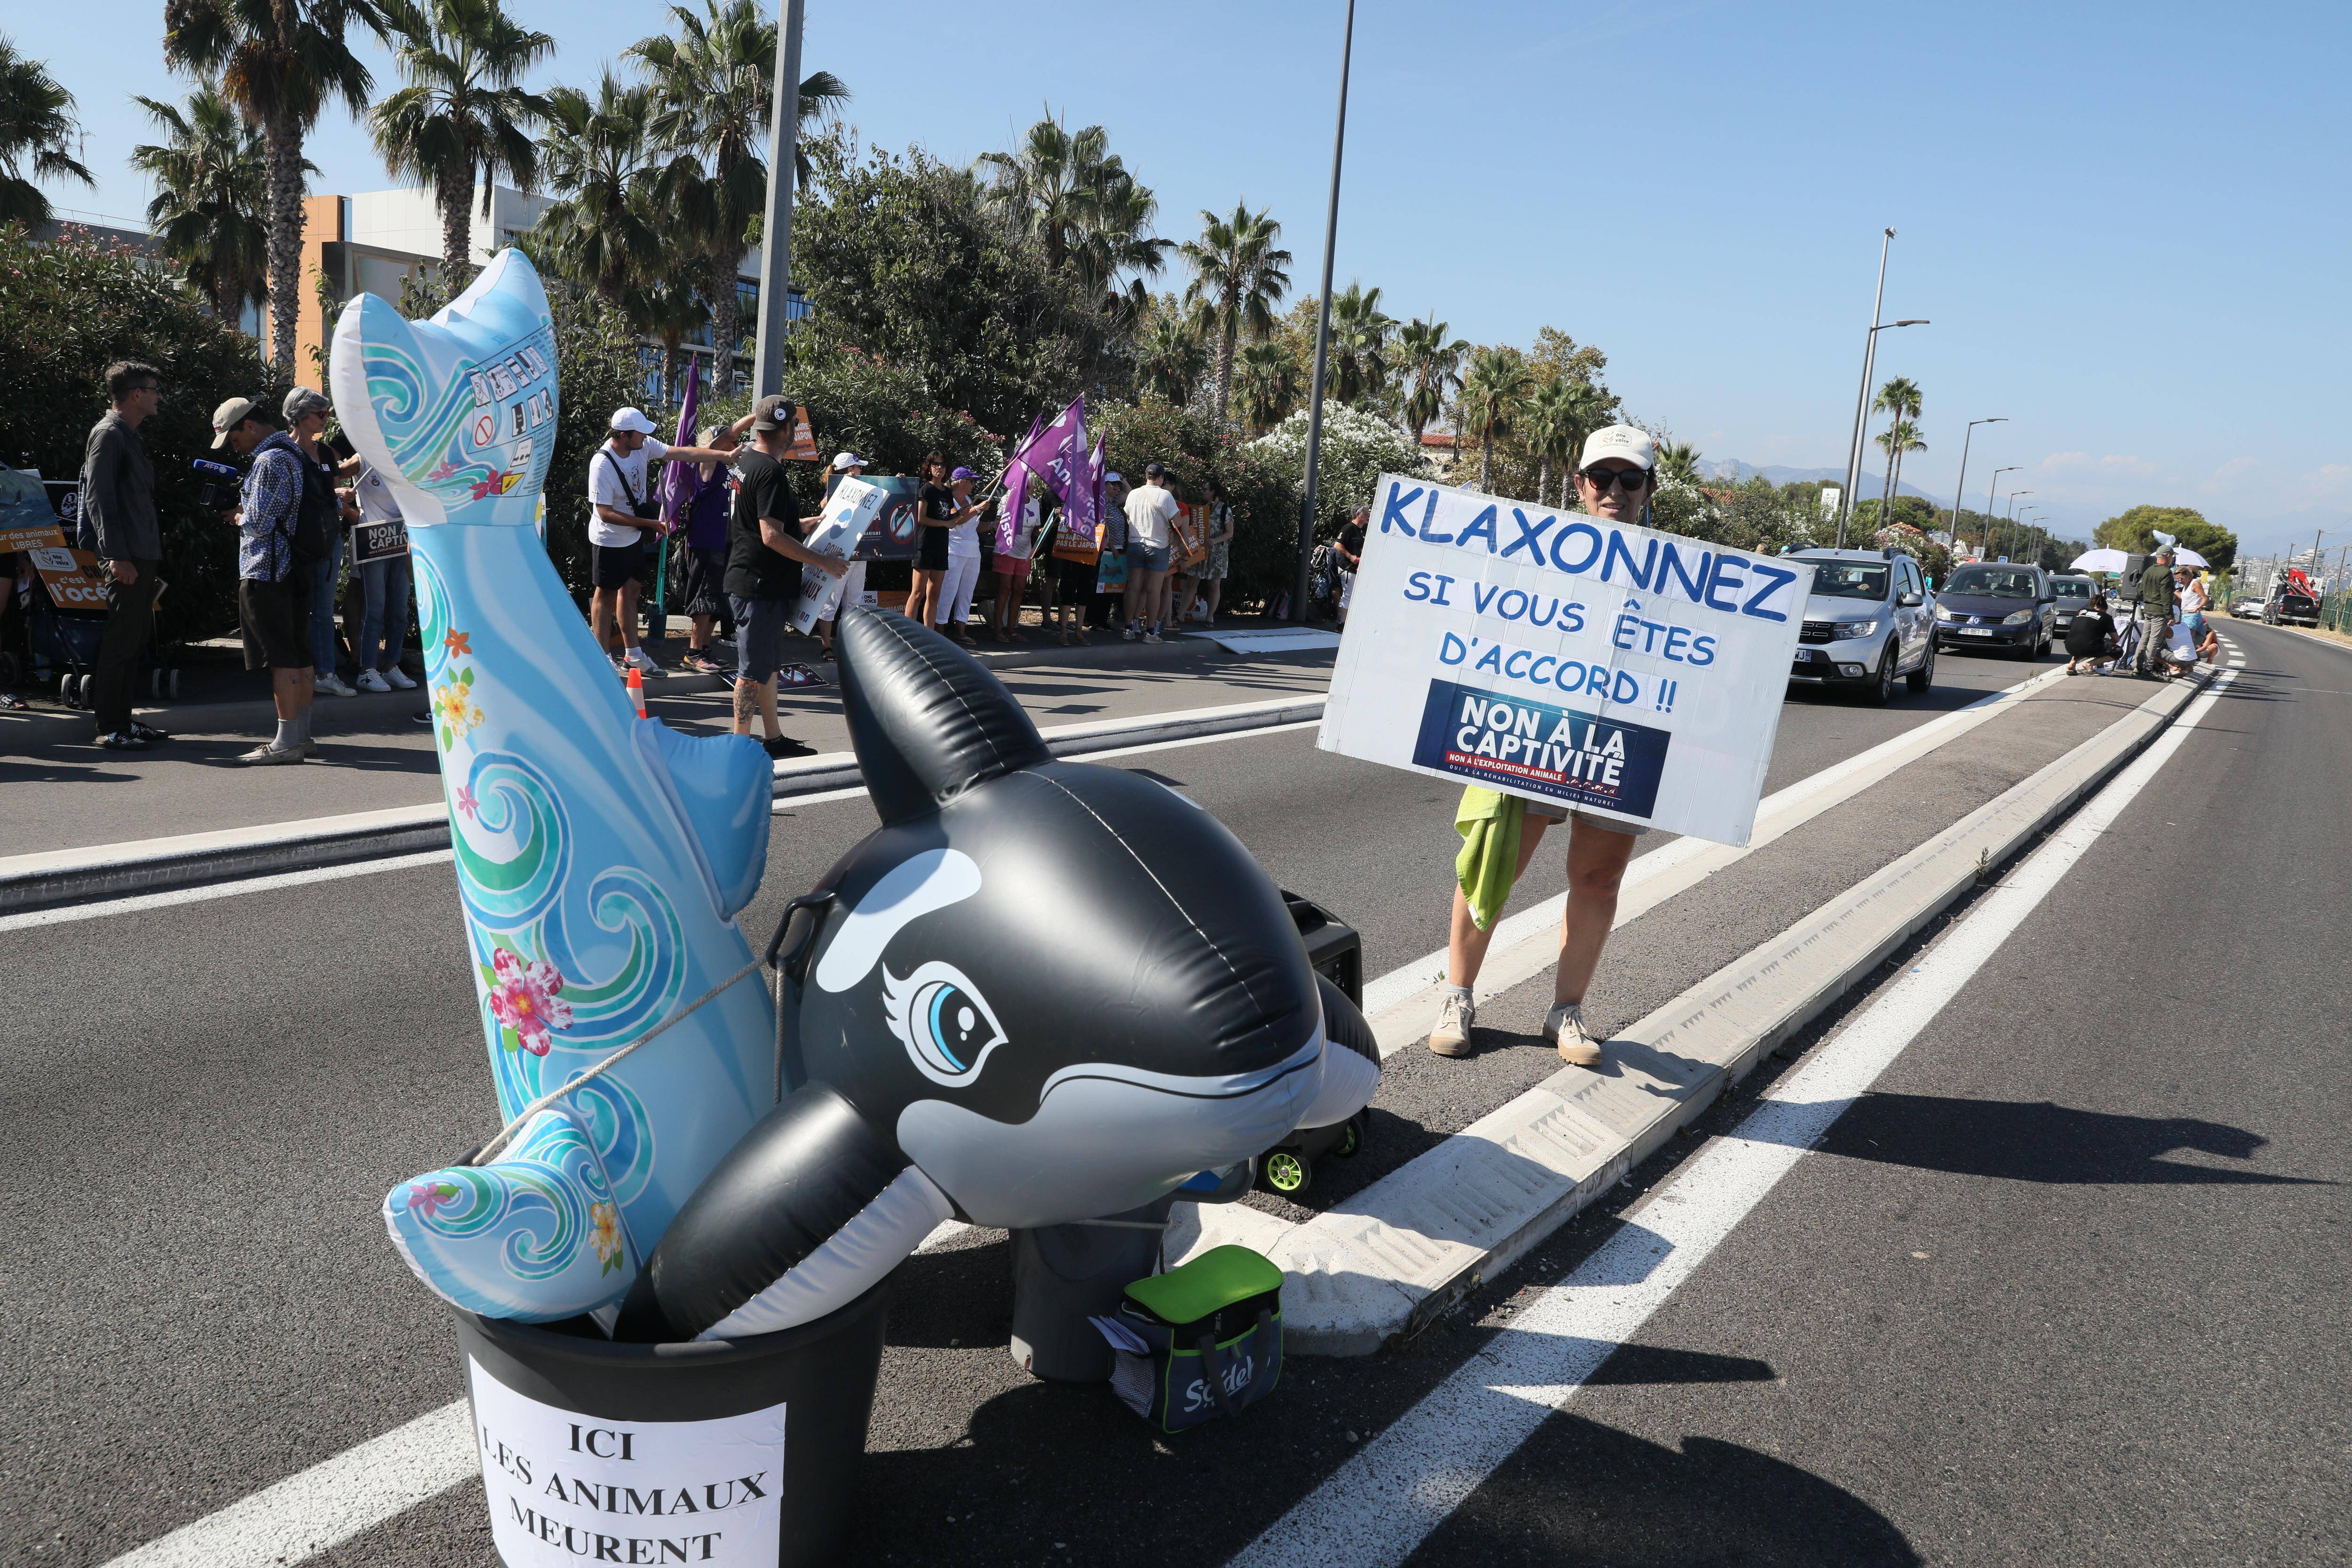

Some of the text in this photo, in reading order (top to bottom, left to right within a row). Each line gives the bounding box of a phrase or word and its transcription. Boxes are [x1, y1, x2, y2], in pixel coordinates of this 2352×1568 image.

[794, 431, 812, 441] JAPON
[838, 484, 878, 510] KLAXONNEZ
[11, 540, 43, 550] LIBRES
[26, 529, 58, 538] animaux
[369, 525, 396, 540] NON
[1381, 481, 1797, 622] KLAXONNEZ
[1404, 572, 1715, 666] SI VOUS ÊTES
[1440, 631, 1677, 714] D'ACCORD !!
[1461, 696, 1626, 760] NON À LA
[1449, 754, 1562, 781] NON À L'EXPLOITATION ANIMALE
[1457, 726, 1624, 787] CAPTIVITÉ
[1484, 773, 1542, 790] RÉHABILITATION
[1584, 796, 1614, 807] NATUREL
[567, 1423, 636, 1460] ICI
[482, 1423, 767, 1516] LES ANIMAUX
[509, 1494, 722, 1565] MEURENT
